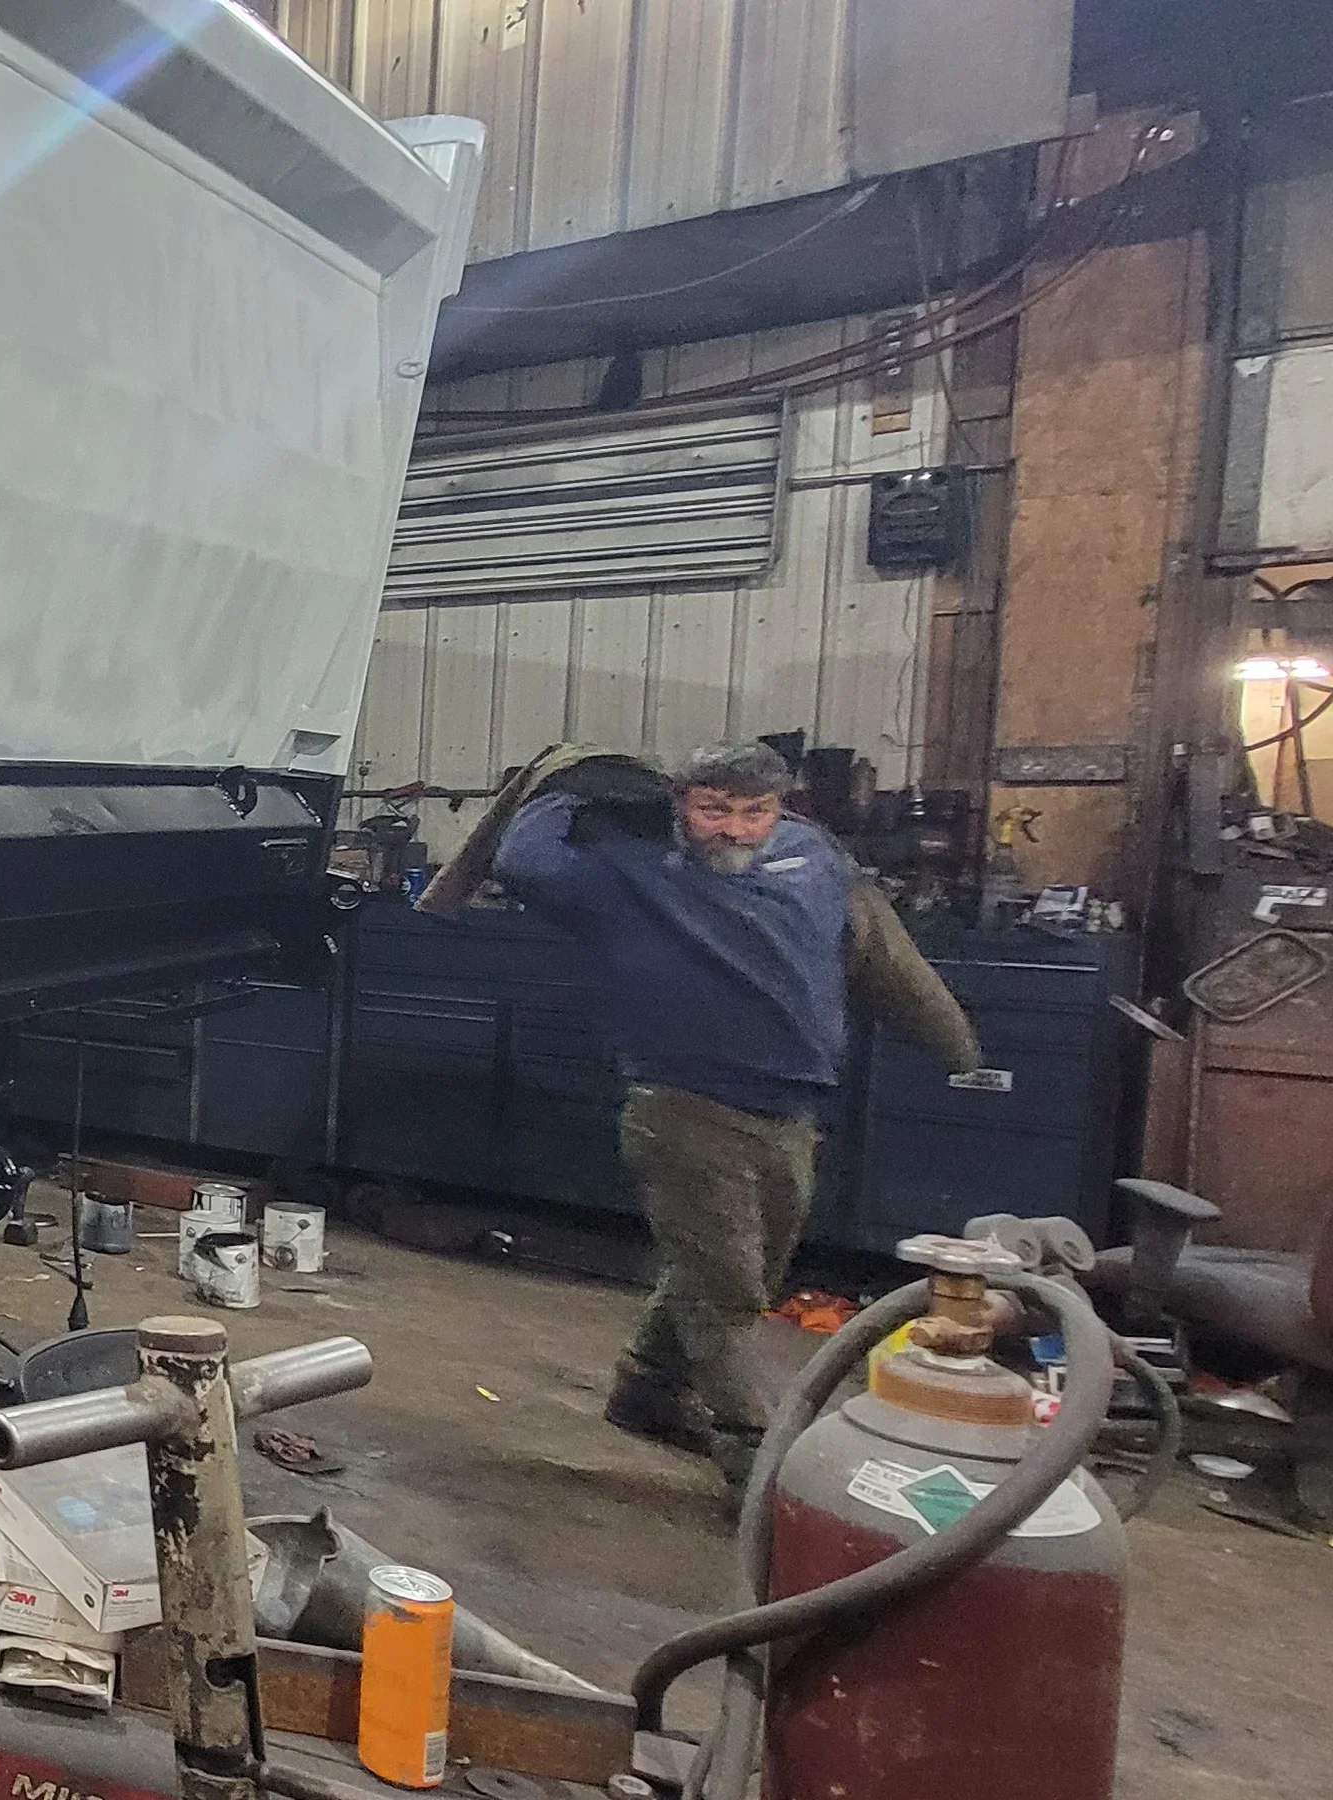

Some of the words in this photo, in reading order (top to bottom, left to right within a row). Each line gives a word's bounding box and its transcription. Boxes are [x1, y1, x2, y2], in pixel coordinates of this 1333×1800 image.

[7, 1590, 37, 1607] 3M
[112, 1589, 130, 1598] 3M
[11, 1773, 106, 1800] MI
